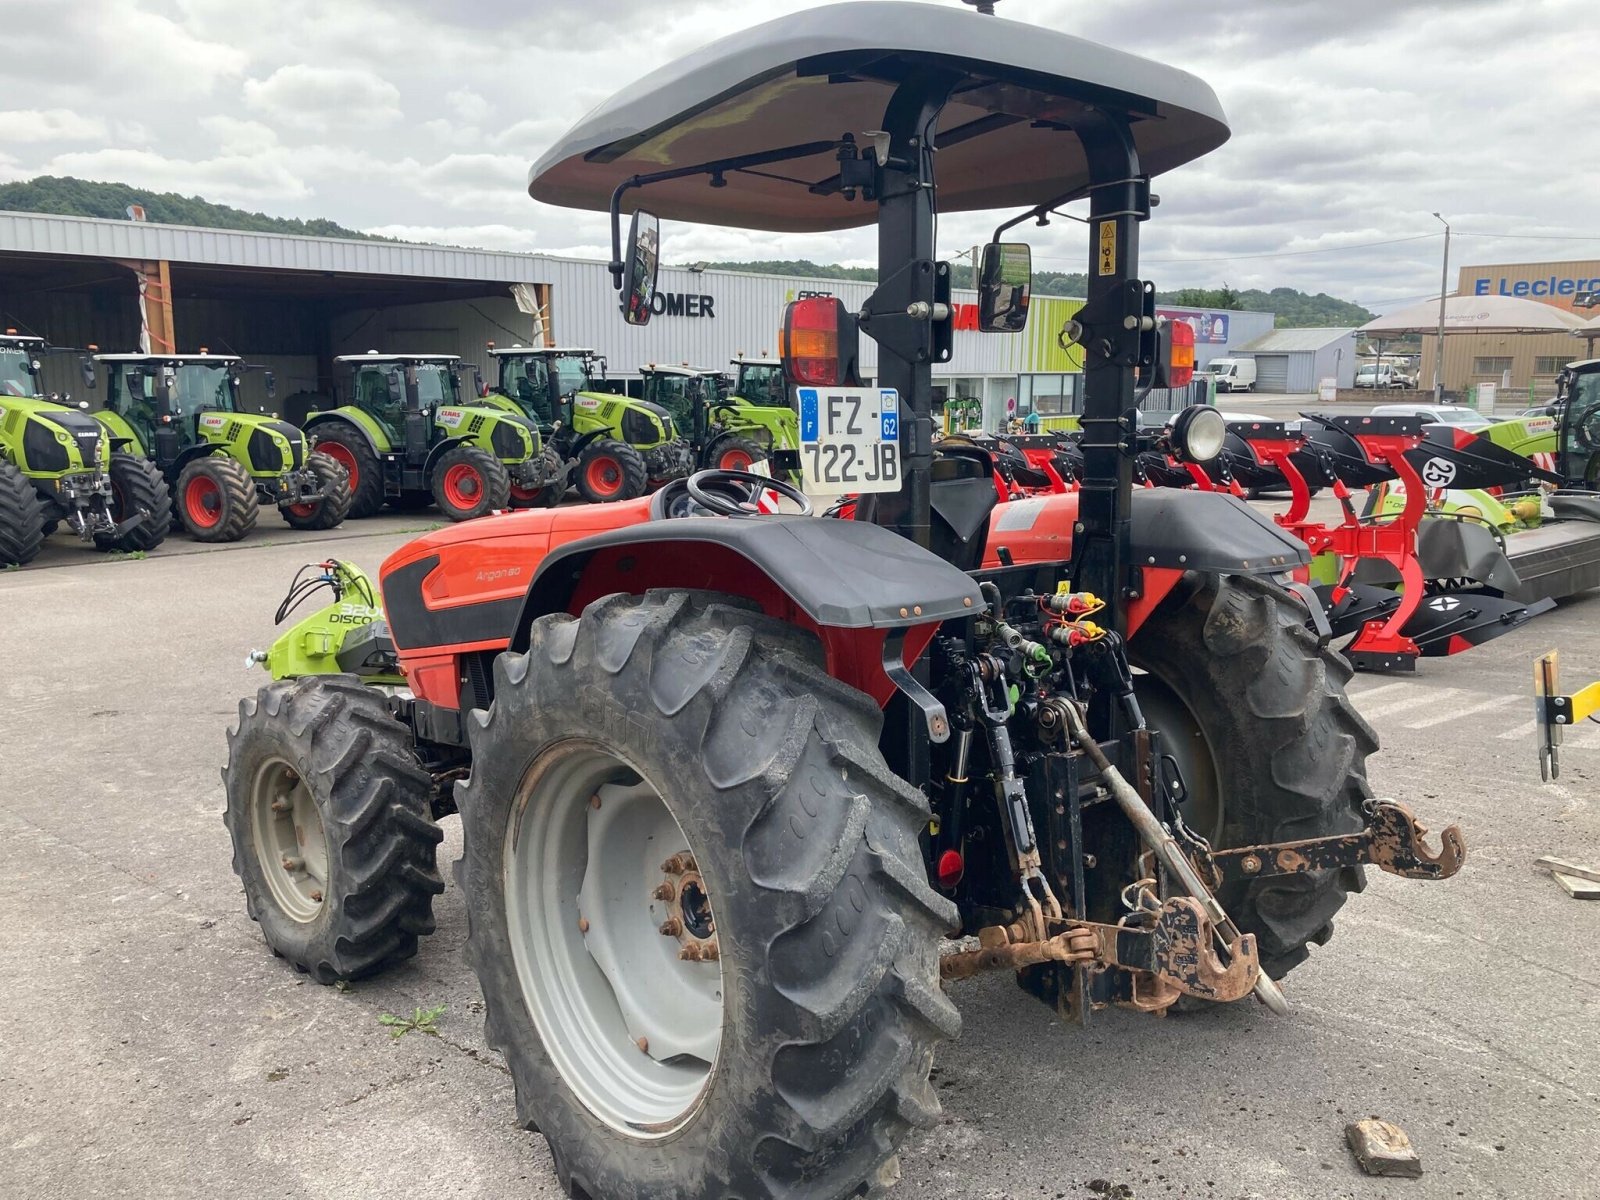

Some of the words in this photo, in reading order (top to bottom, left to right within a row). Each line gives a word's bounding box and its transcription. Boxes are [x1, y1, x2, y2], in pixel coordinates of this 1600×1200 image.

[1475, 279, 1491, 296] E
[883, 418, 896, 435] 62
[1425, 461, 1454, 484] 25
[329, 614, 373, 625] DISCO
